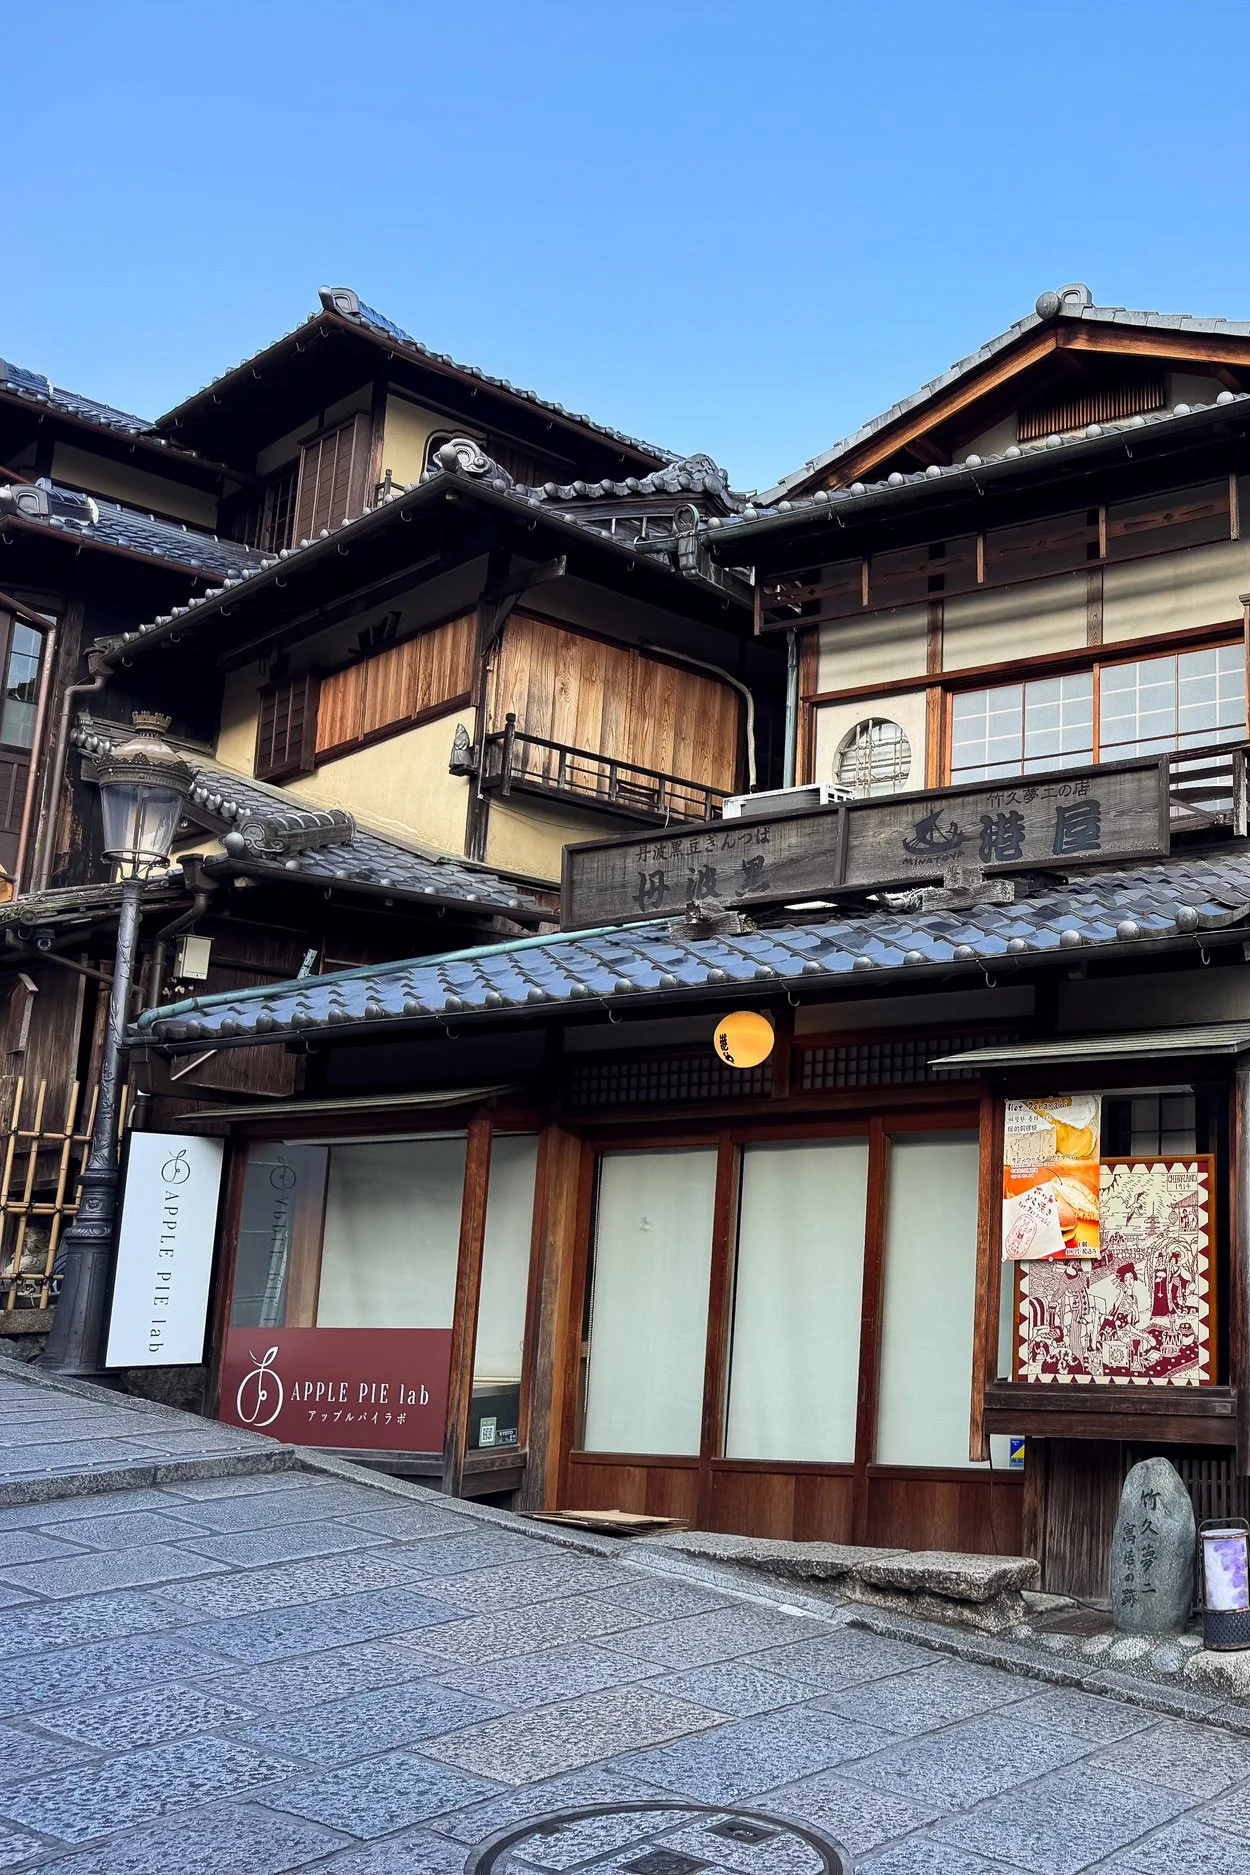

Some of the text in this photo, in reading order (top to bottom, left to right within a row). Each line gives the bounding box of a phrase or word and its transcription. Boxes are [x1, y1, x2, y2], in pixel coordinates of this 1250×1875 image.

[987, 780, 1090, 808] 竹久夢二の店
[979, 799, 1101, 863] 港屋
[902, 850, 965, 865] MINATOYA
[632, 855, 770, 912] 丹波黒
[148, 1190, 180, 1353] APPLE PIE lab
[291, 1381, 429, 1406] APPLE PIE lab
[308, 1410, 407, 1425] アップルパイラボ
[1140, 1488, 1162, 1594] 竹久夢二
